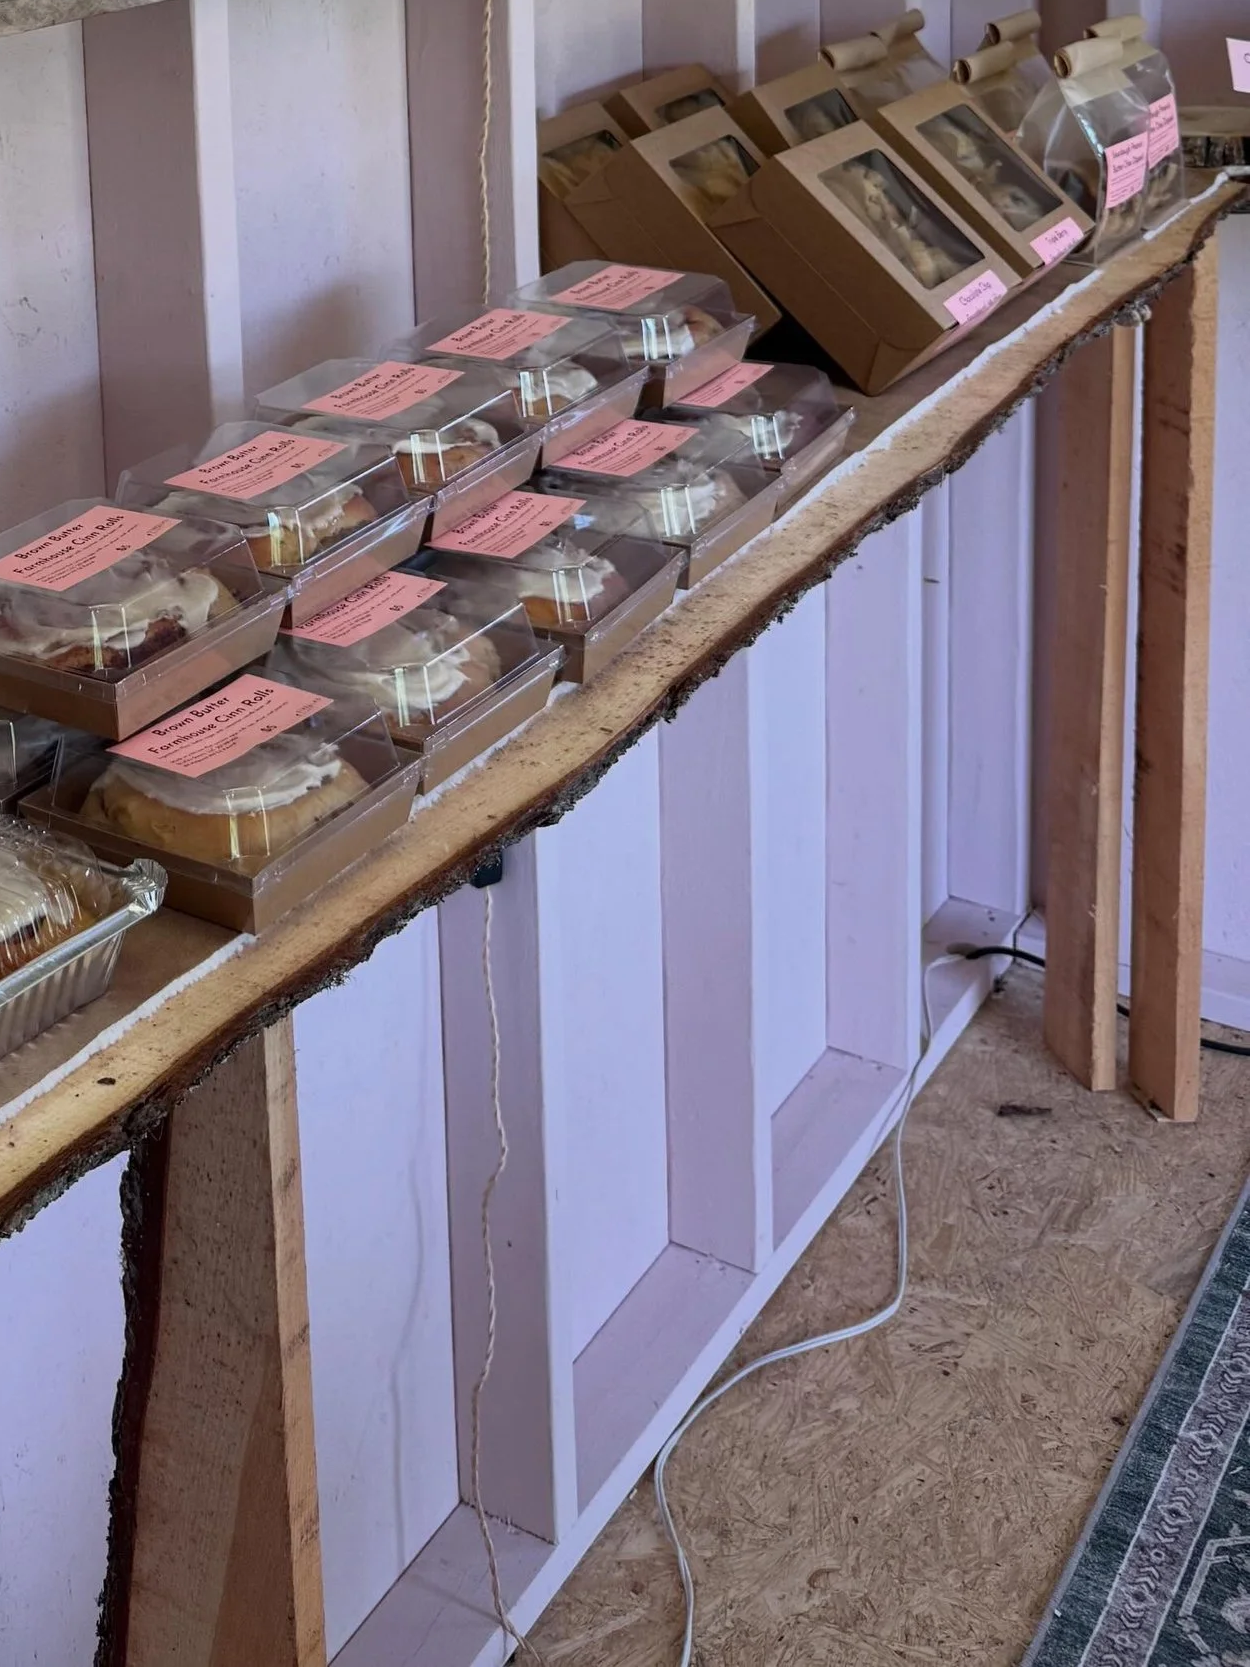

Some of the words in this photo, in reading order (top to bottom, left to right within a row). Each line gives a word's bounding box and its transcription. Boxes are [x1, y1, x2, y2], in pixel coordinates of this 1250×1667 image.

[199, 460, 231, 475] Brown
[227, 445, 258, 462] Butter
[200, 463, 250, 485] Farmhouse
[249, 449, 273, 465] Cinn
[274, 438, 296, 453] Rolls
[13, 545, 74, 575] Farmhouse
[71, 530, 100, 547] Cinn
[96, 514, 125, 532] Rolls
[14, 541, 52, 560] Brown
[48, 523, 84, 543] Butter
[148, 723, 217, 755] Farmhouse
[215, 705, 246, 724] Cinn
[243, 687, 275, 708] Rolls
[152, 715, 194, 737] Brown
[190, 696, 230, 718] Butter
